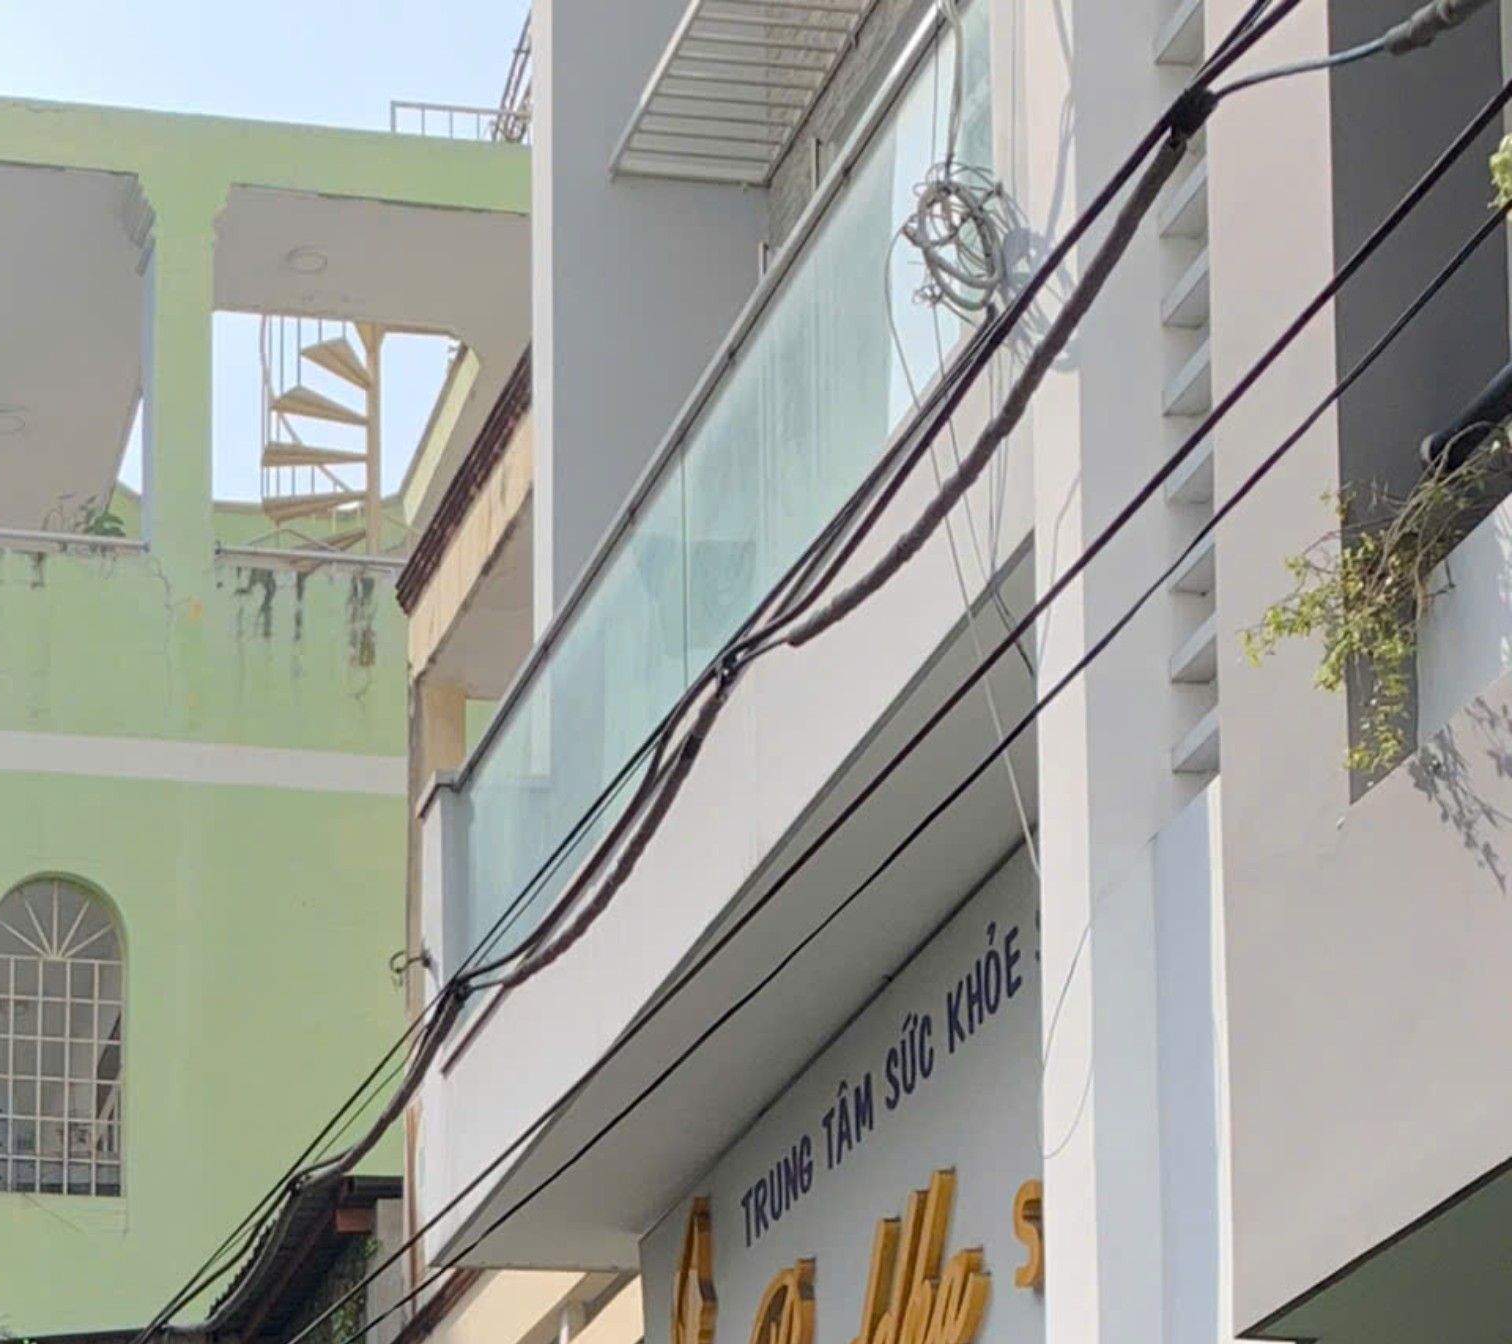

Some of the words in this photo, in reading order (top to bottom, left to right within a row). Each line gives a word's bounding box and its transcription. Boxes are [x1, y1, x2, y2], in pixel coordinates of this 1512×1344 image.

[740, 1134, 815, 1248] TRUNG
[821, 1079, 874, 1170] TÂM
[886, 1012, 935, 1110] SỨC
[946, 921, 1024, 1054] KHỎE
